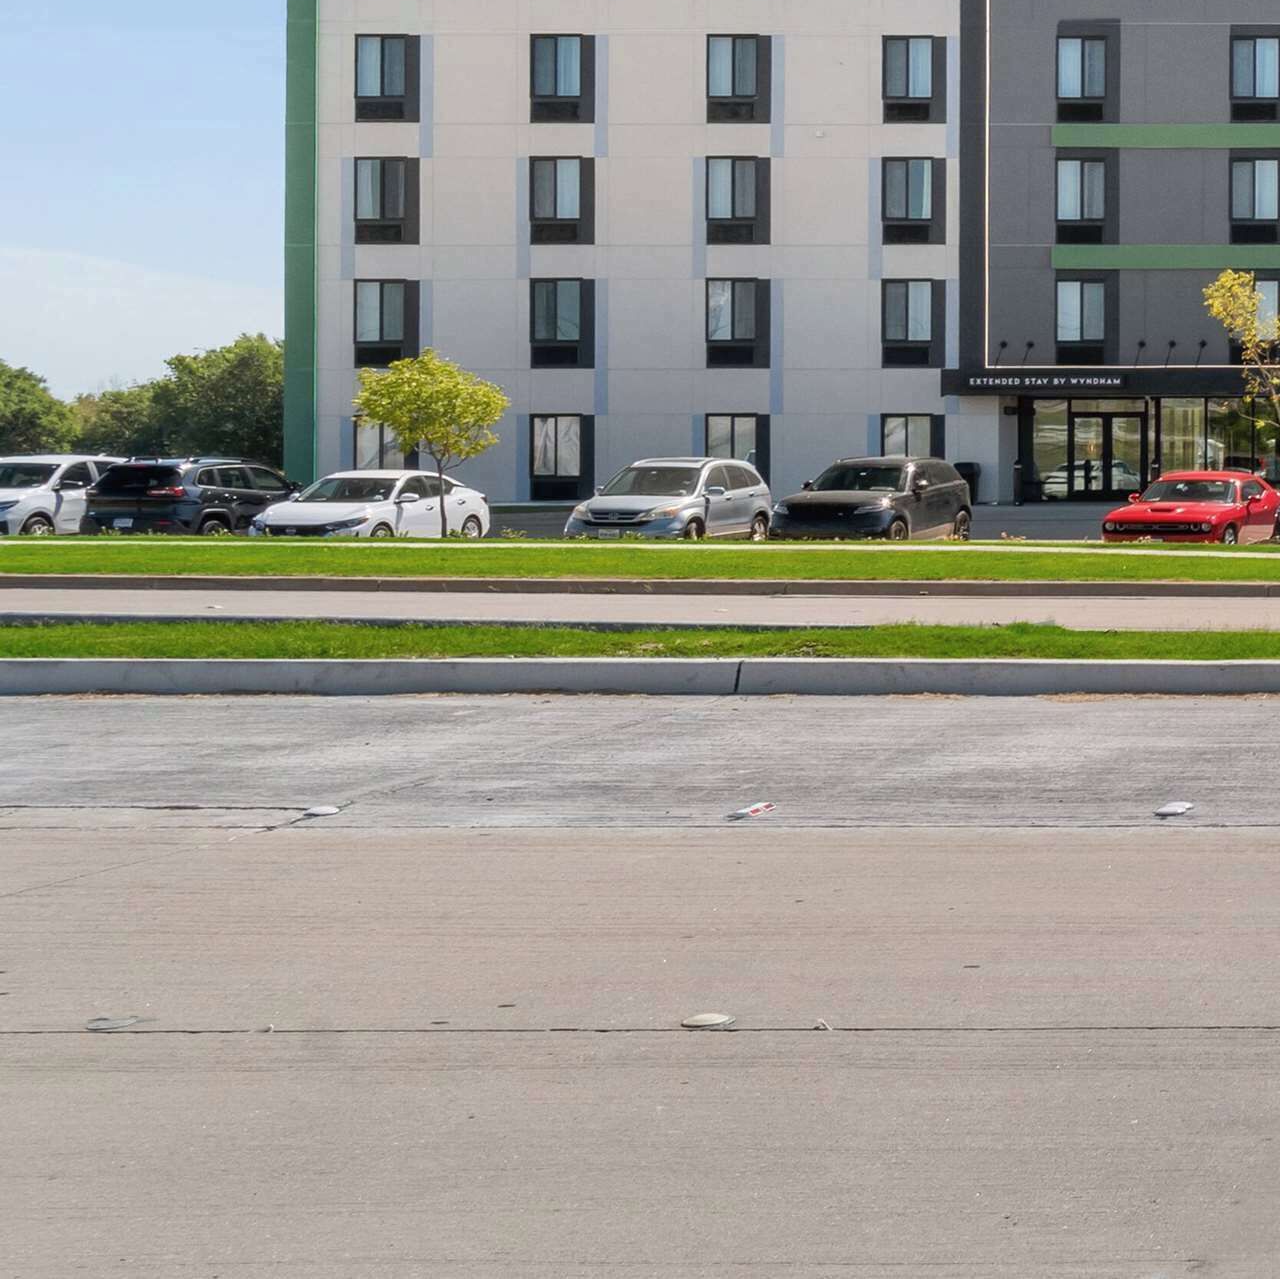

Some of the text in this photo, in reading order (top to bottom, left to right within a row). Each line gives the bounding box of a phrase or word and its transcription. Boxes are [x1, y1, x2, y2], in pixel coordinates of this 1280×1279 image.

[969, 377, 1121, 385] EXTENDED STAY BY WYNDHAM
